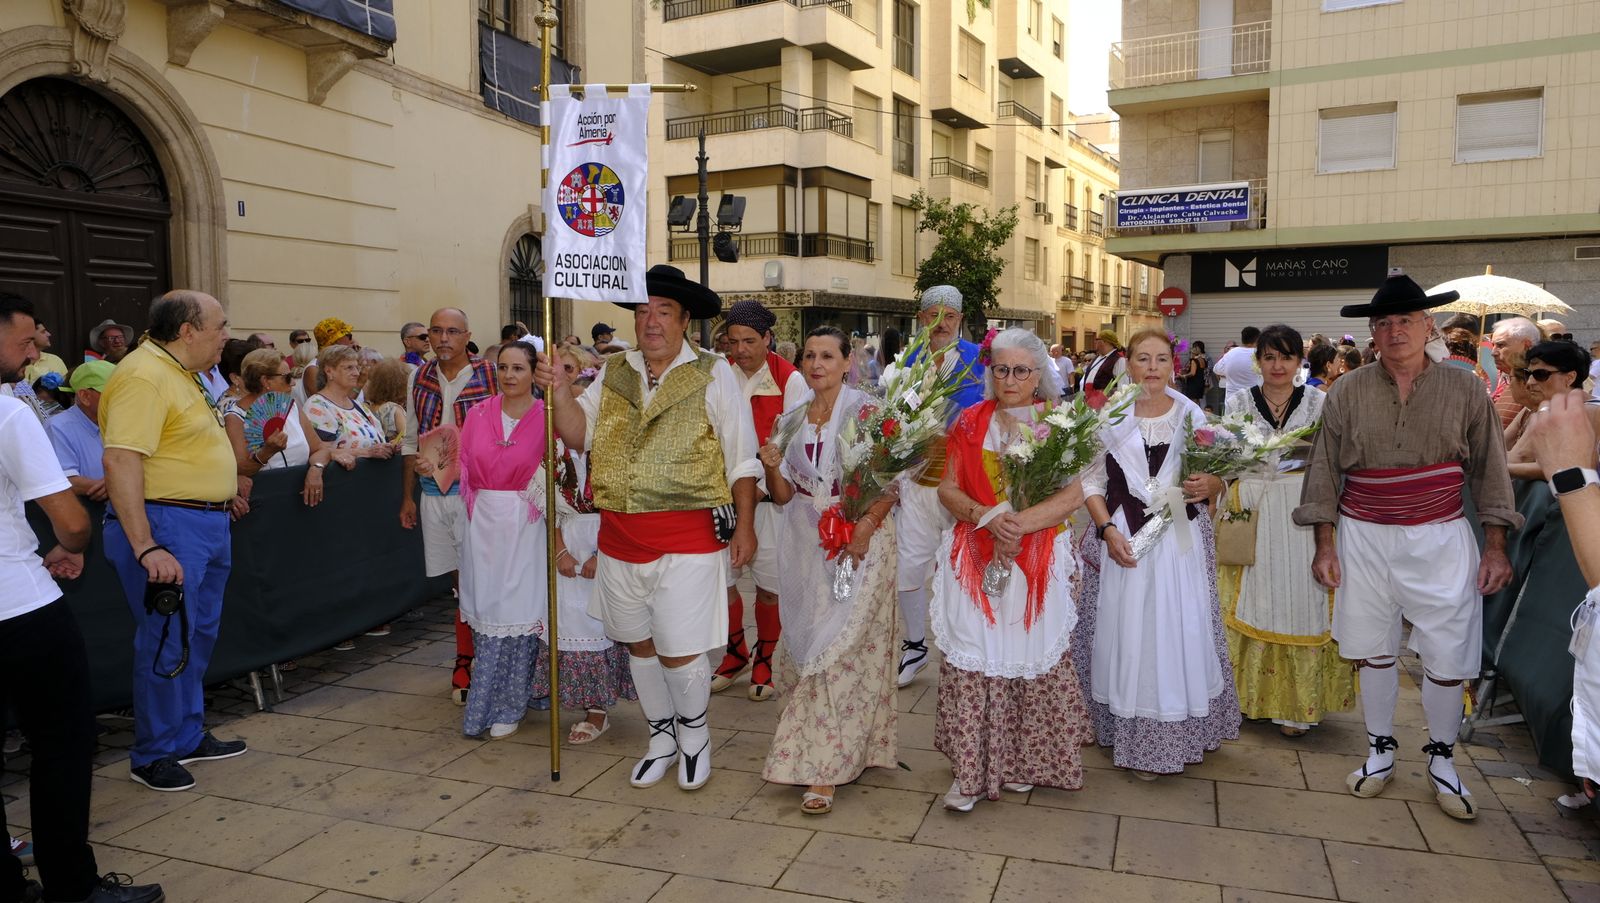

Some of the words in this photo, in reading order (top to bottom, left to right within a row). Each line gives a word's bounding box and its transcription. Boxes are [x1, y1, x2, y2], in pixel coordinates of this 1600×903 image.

[577, 111, 602, 126] Acción
[604, 113, 616, 127] por
[579, 124, 607, 139] Almería
[1121, 195, 1179, 206] CLINICA
[1185, 189, 1245, 202] DENTAL
[1149, 205, 1185, 213] Implantes
[555, 253, 627, 271] ASOCIACION
[1266, 259, 1306, 270] MAÑAS
[1312, 258, 1349, 269] CANO
[554, 271, 629, 290] CULTURAL
[1265, 269, 1348, 278] INMOBILIARIA
